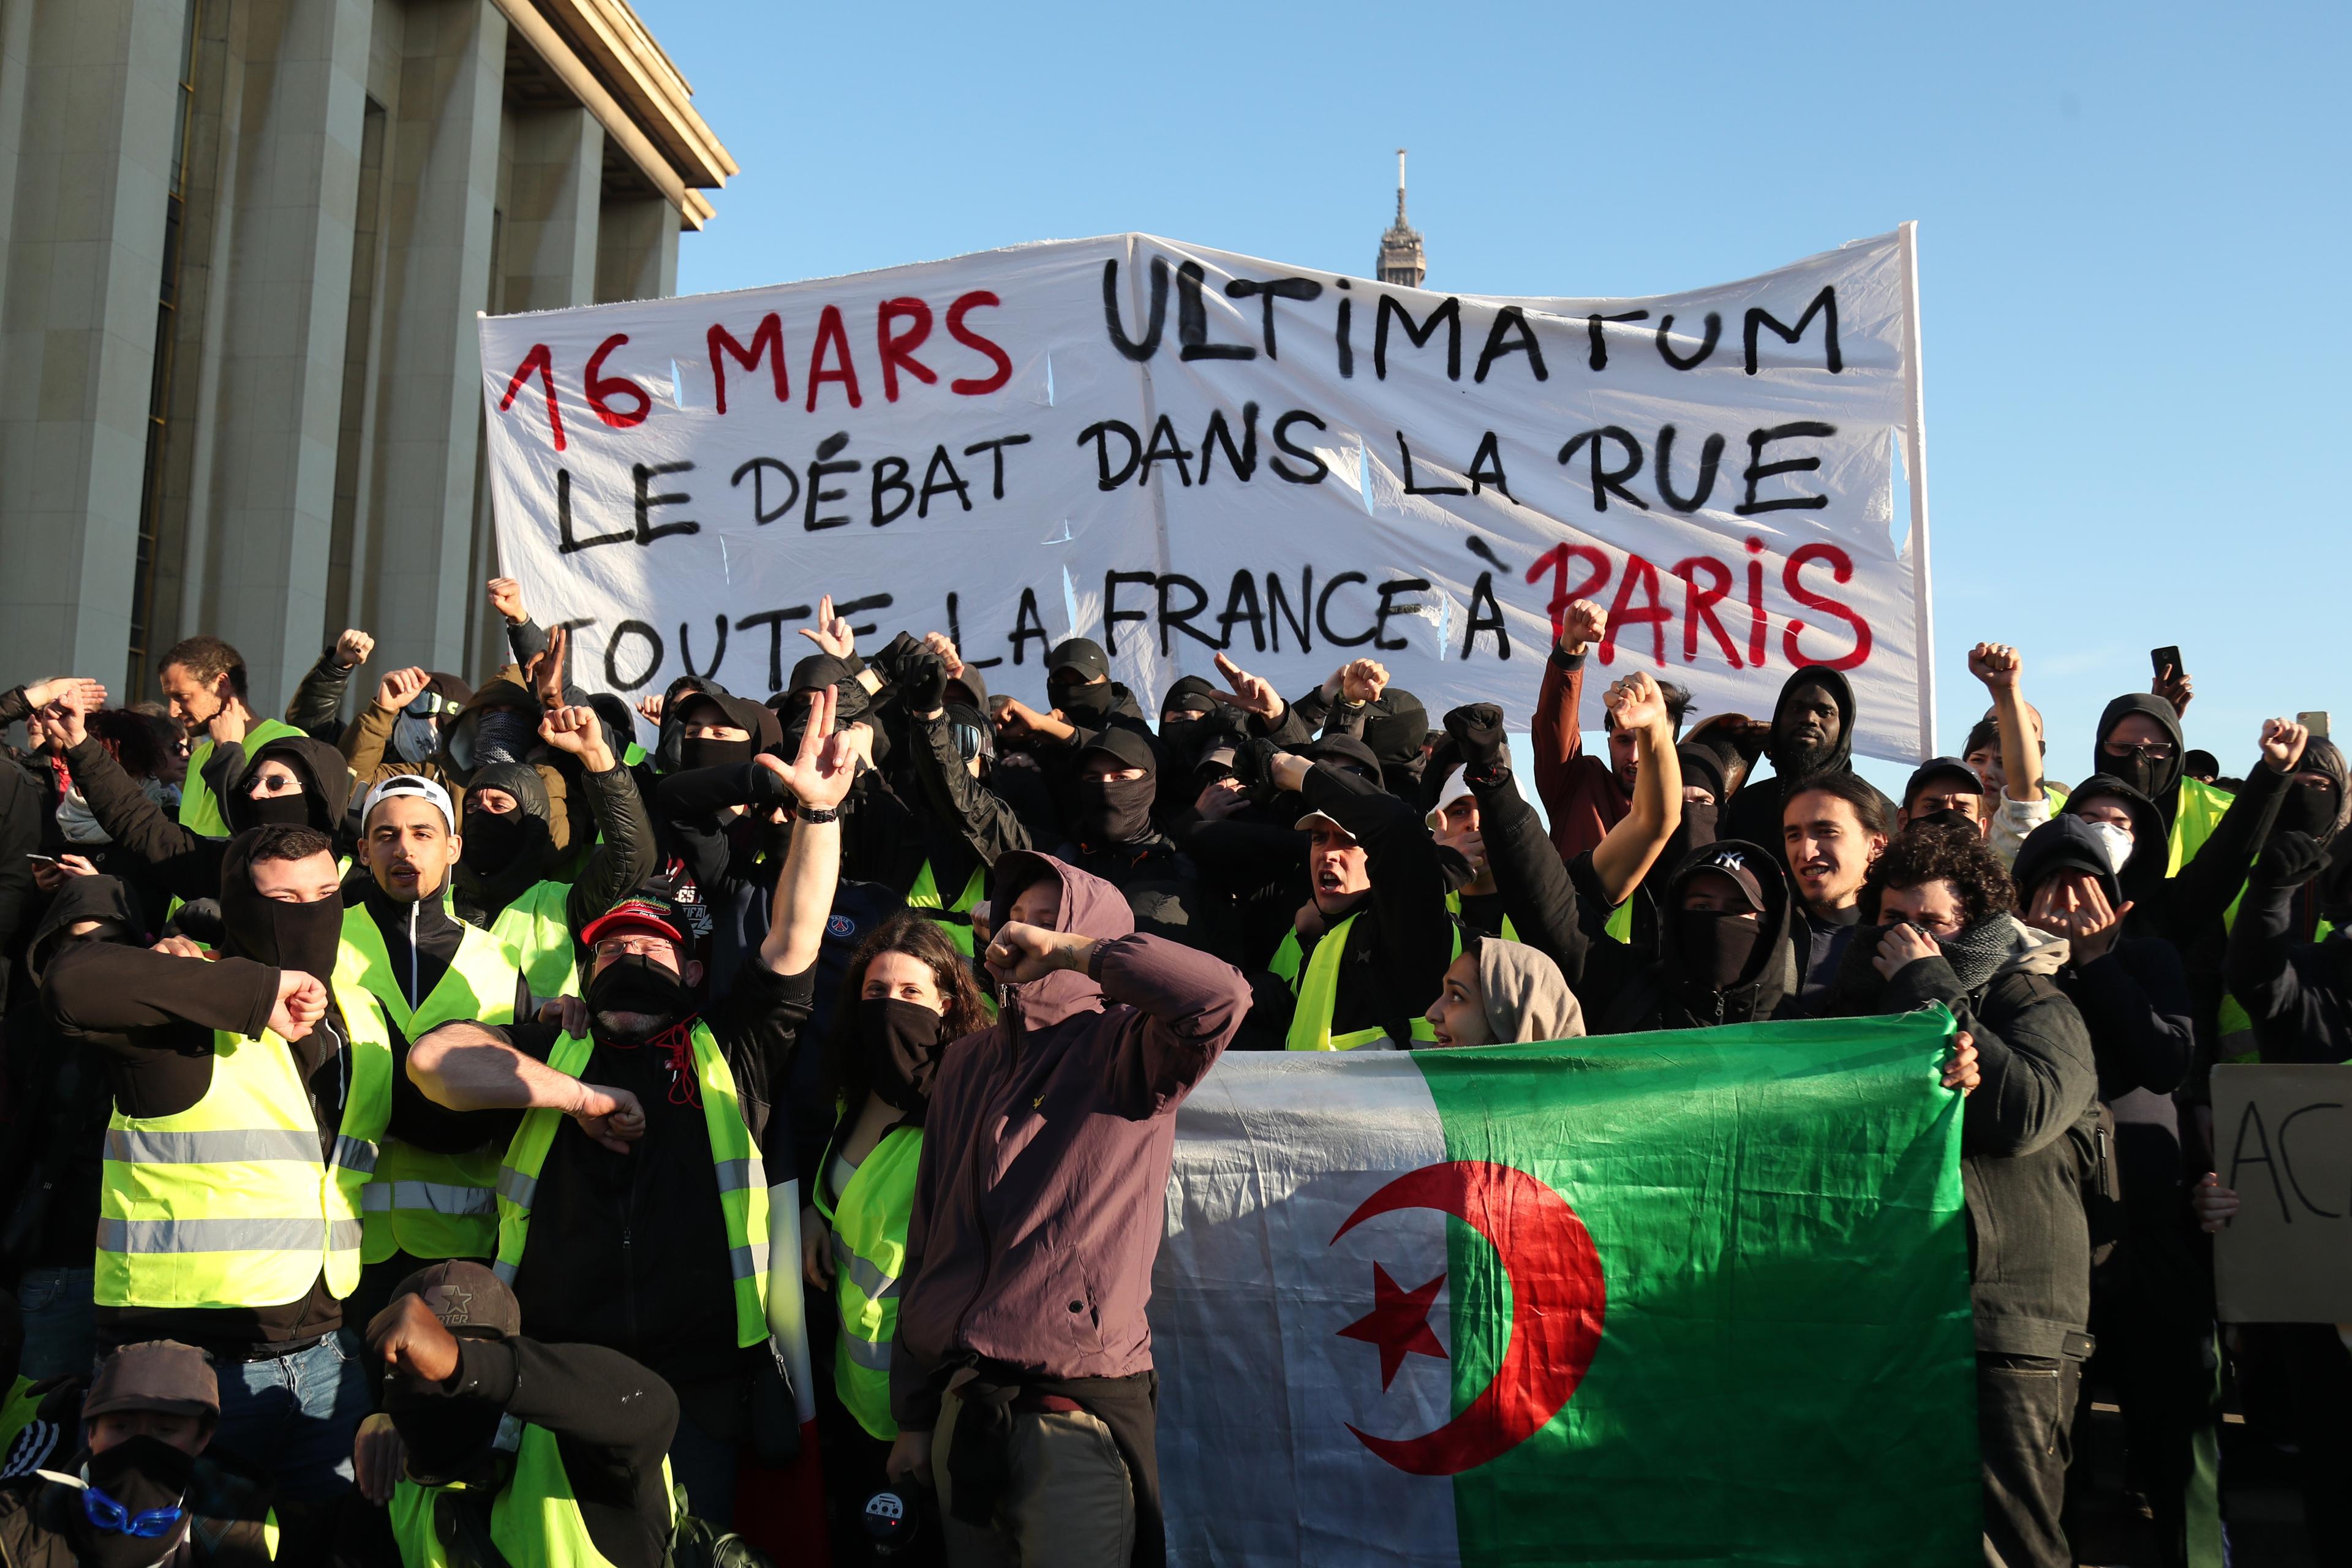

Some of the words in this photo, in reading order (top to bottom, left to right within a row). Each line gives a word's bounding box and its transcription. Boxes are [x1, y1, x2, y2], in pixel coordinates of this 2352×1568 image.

[500, 333, 652, 451] 16
[706, 290, 1013, 415] MARS
[557, 460, 701, 554] LE
[730, 431, 1032, 532] DÉBAT
[1077, 400, 1330, 491] DANS
[1395, 431, 1520, 505] LA
[1557, 420, 1839, 516] RUE
[946, 587, 1051, 669] LA
[1103, 564, 1432, 658] FRANCE
[1459, 535, 1513, 661] À
[2225, 1101, 2352, 1227] AC
